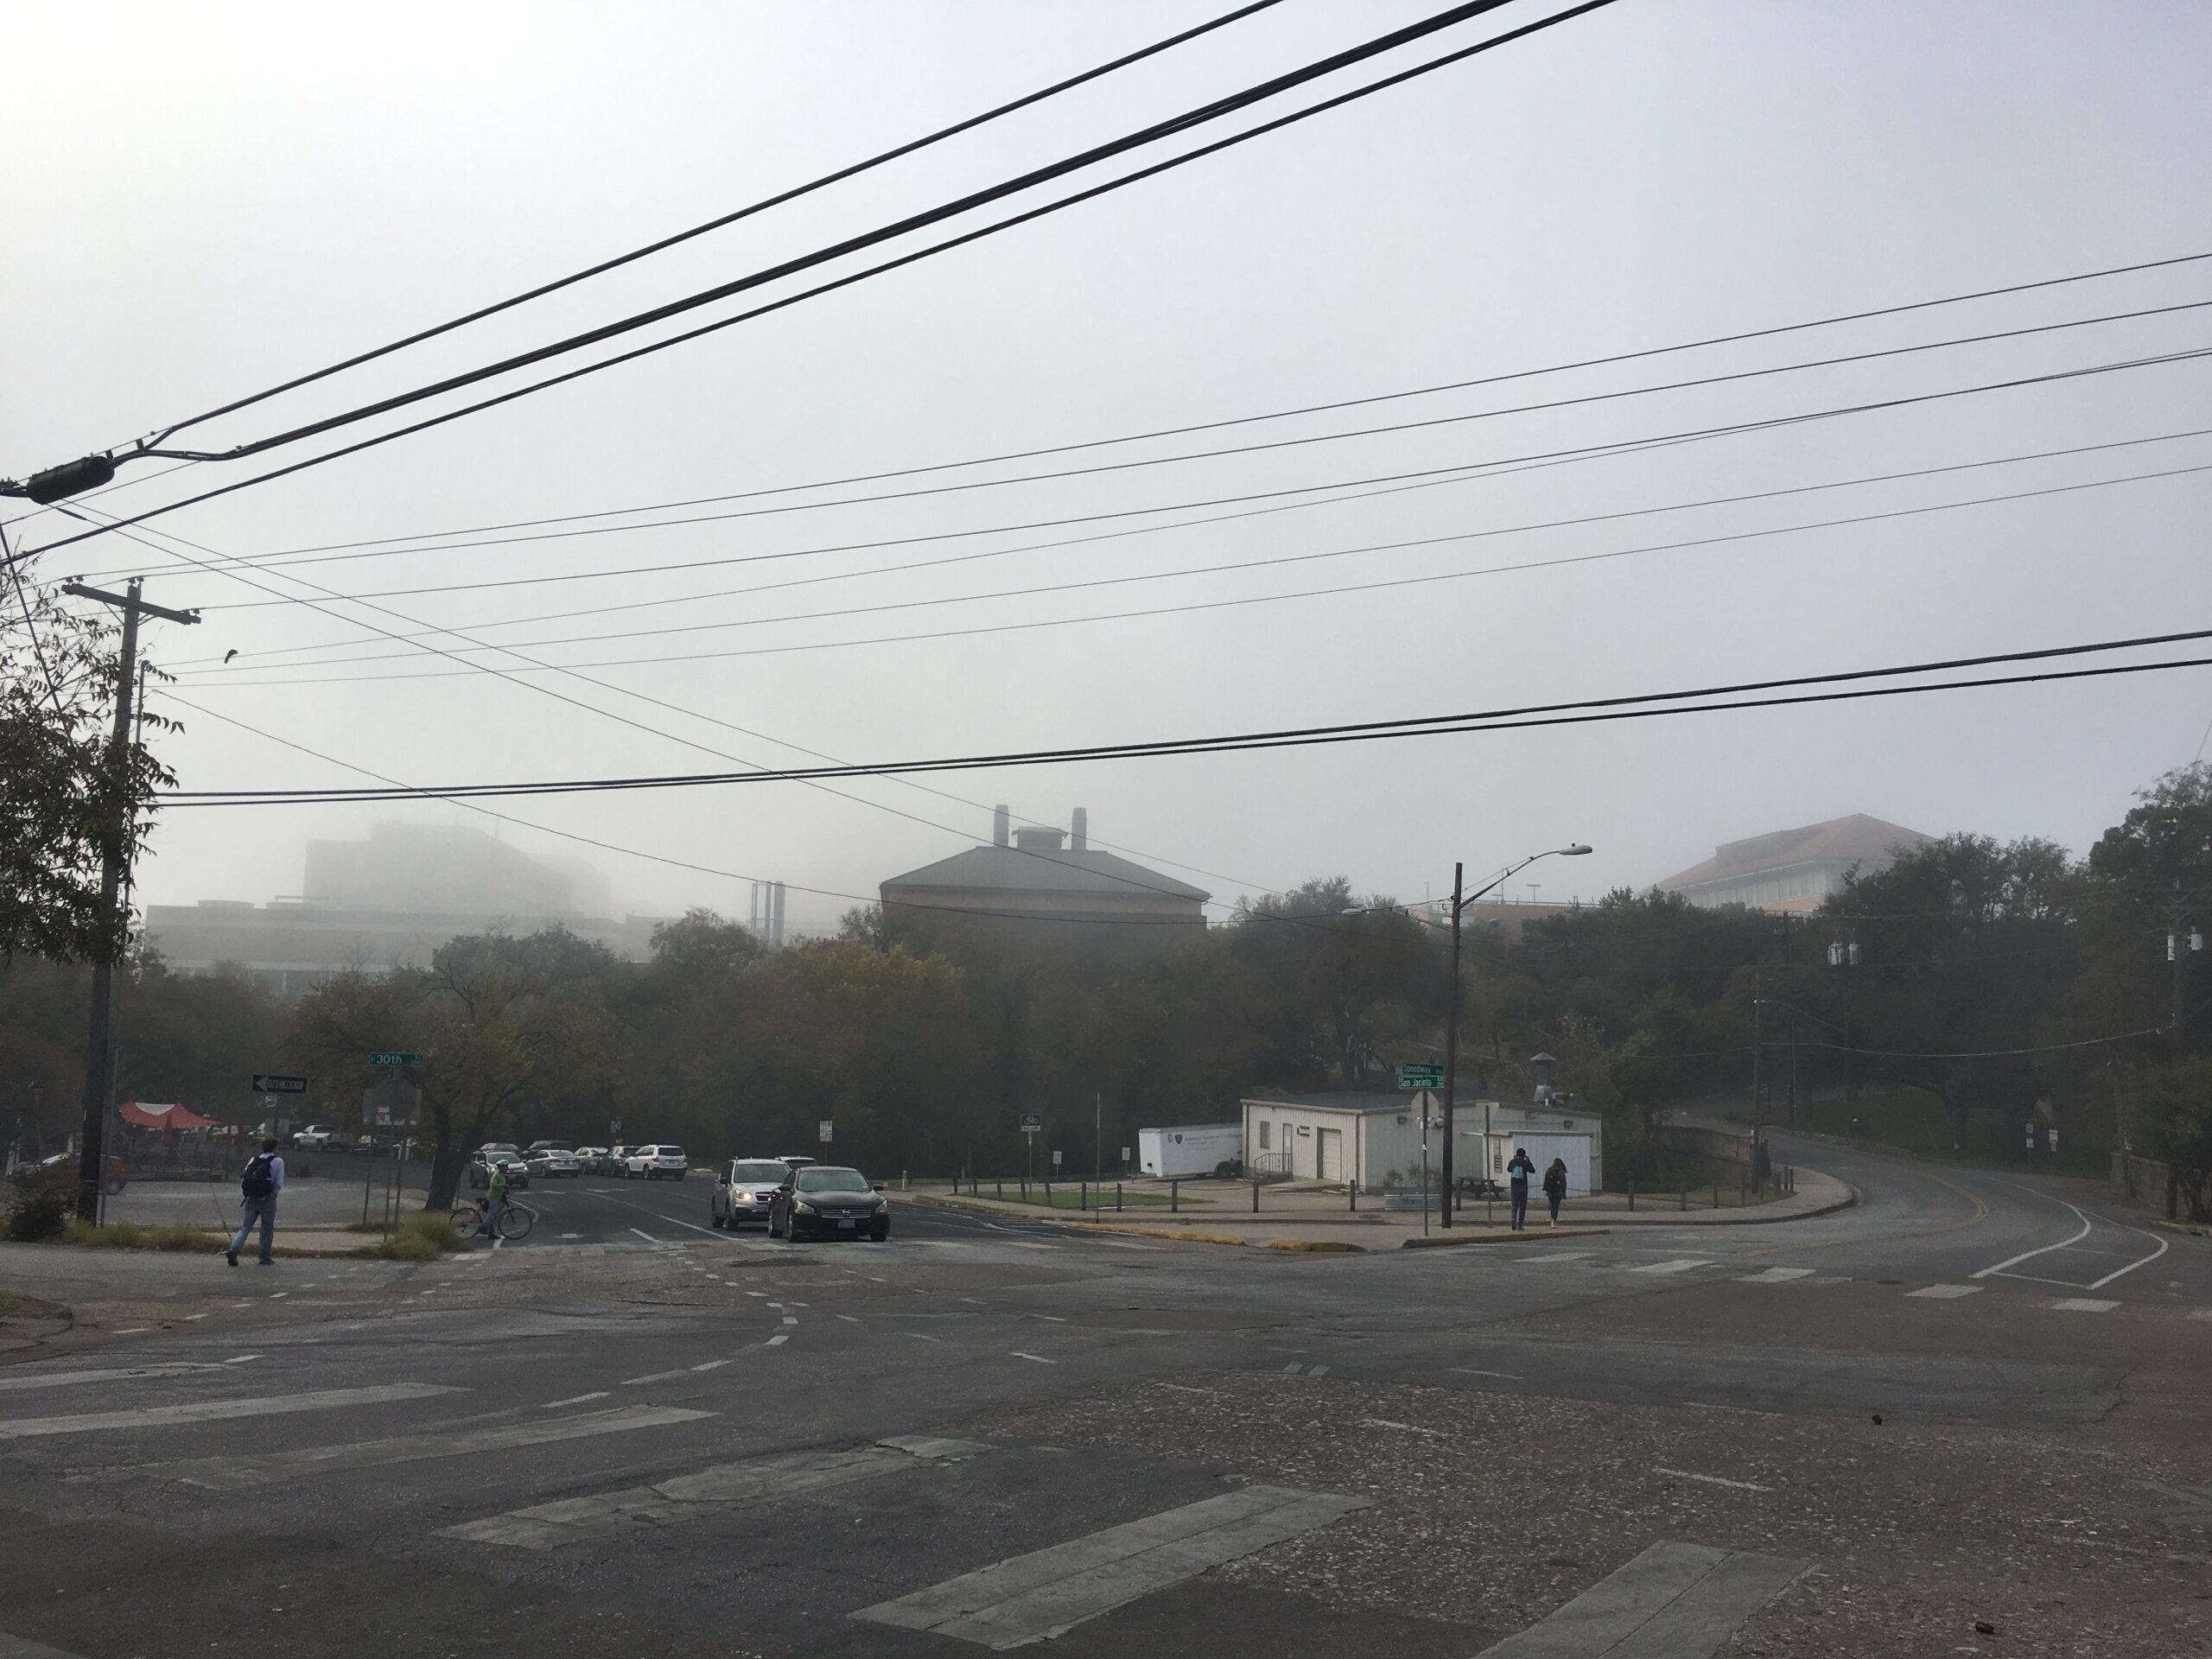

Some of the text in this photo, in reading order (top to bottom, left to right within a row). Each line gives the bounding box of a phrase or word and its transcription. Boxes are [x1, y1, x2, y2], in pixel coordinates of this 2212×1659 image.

[376, 1054, 402, 1065] 30th
[1402, 1064, 1431, 1075] Speedway
[265, 1079, 301, 1089] ONE WAY
[1400, 1078, 1410, 1087] San
[1413, 1078, 1432, 1087] Jacinto
